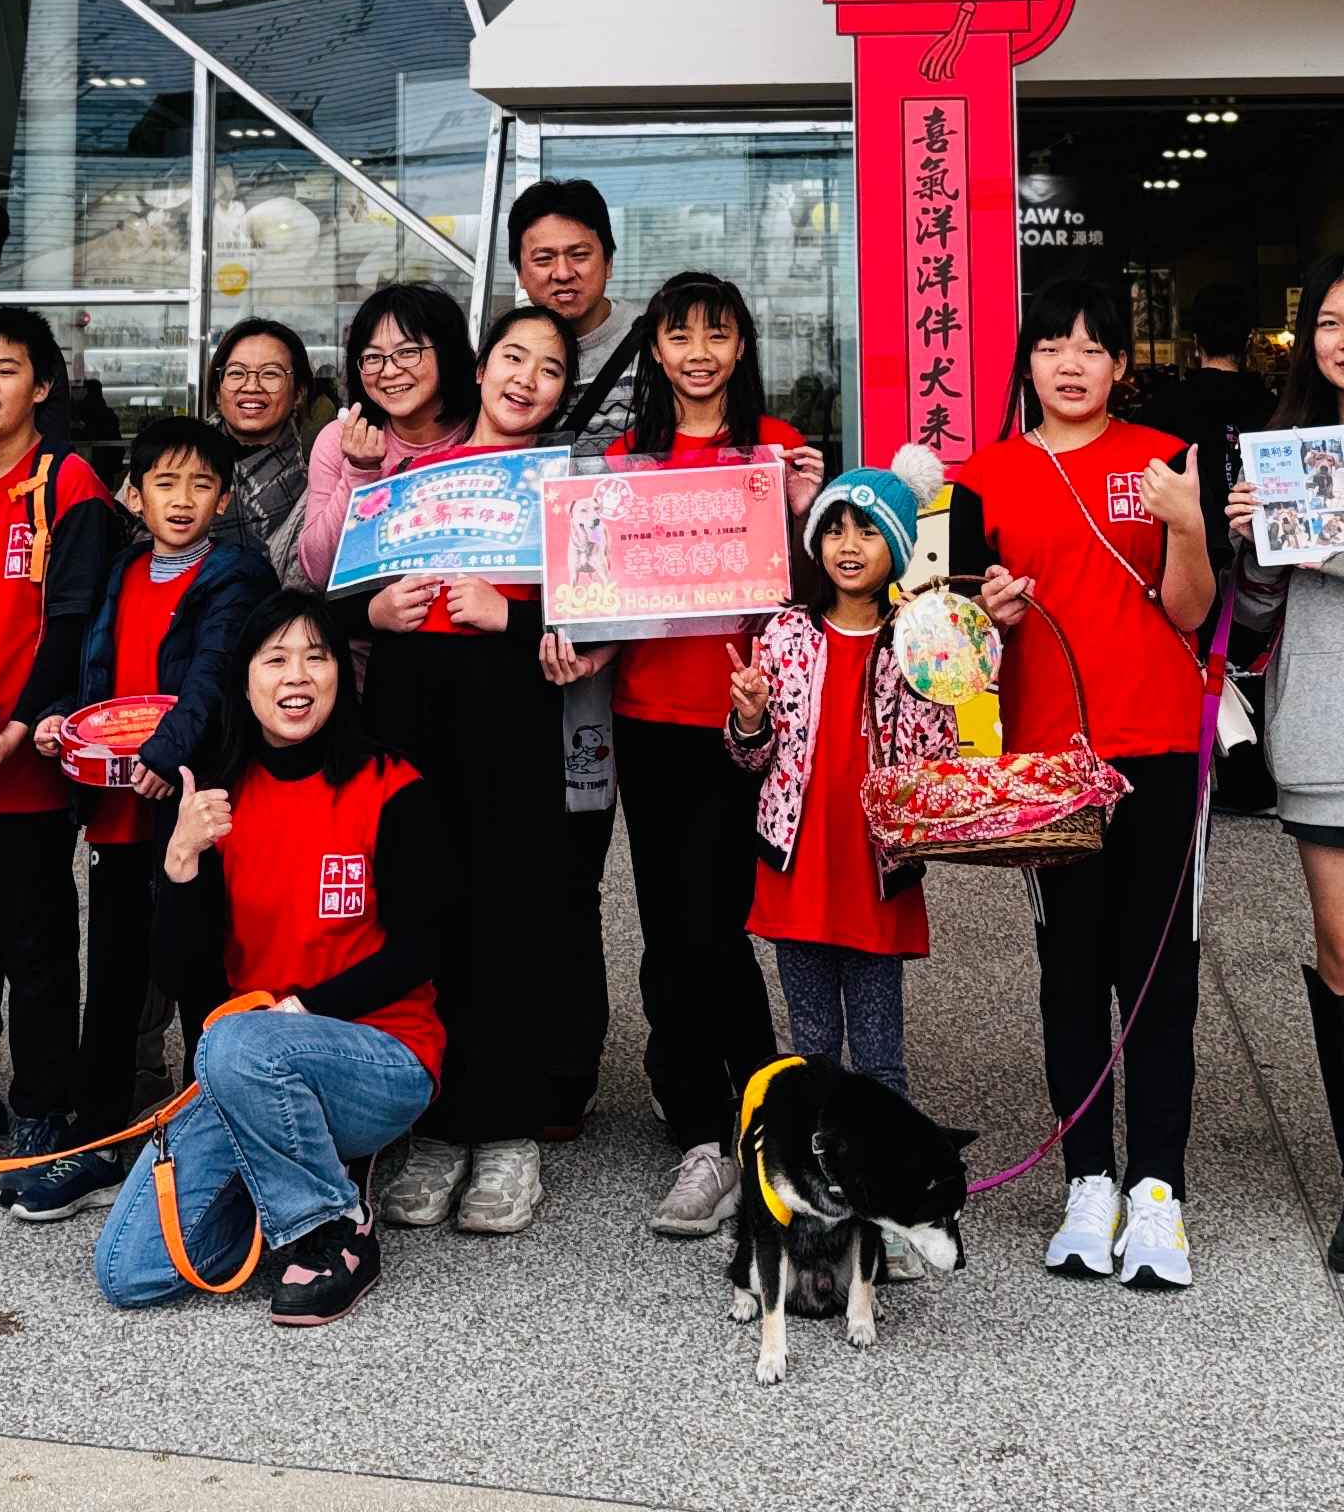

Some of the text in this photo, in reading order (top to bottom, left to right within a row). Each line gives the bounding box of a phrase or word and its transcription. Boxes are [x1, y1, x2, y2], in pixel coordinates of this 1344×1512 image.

[1064, 209, 1085, 225] to
[555, 582, 785, 616] 2026 Happy New Year
